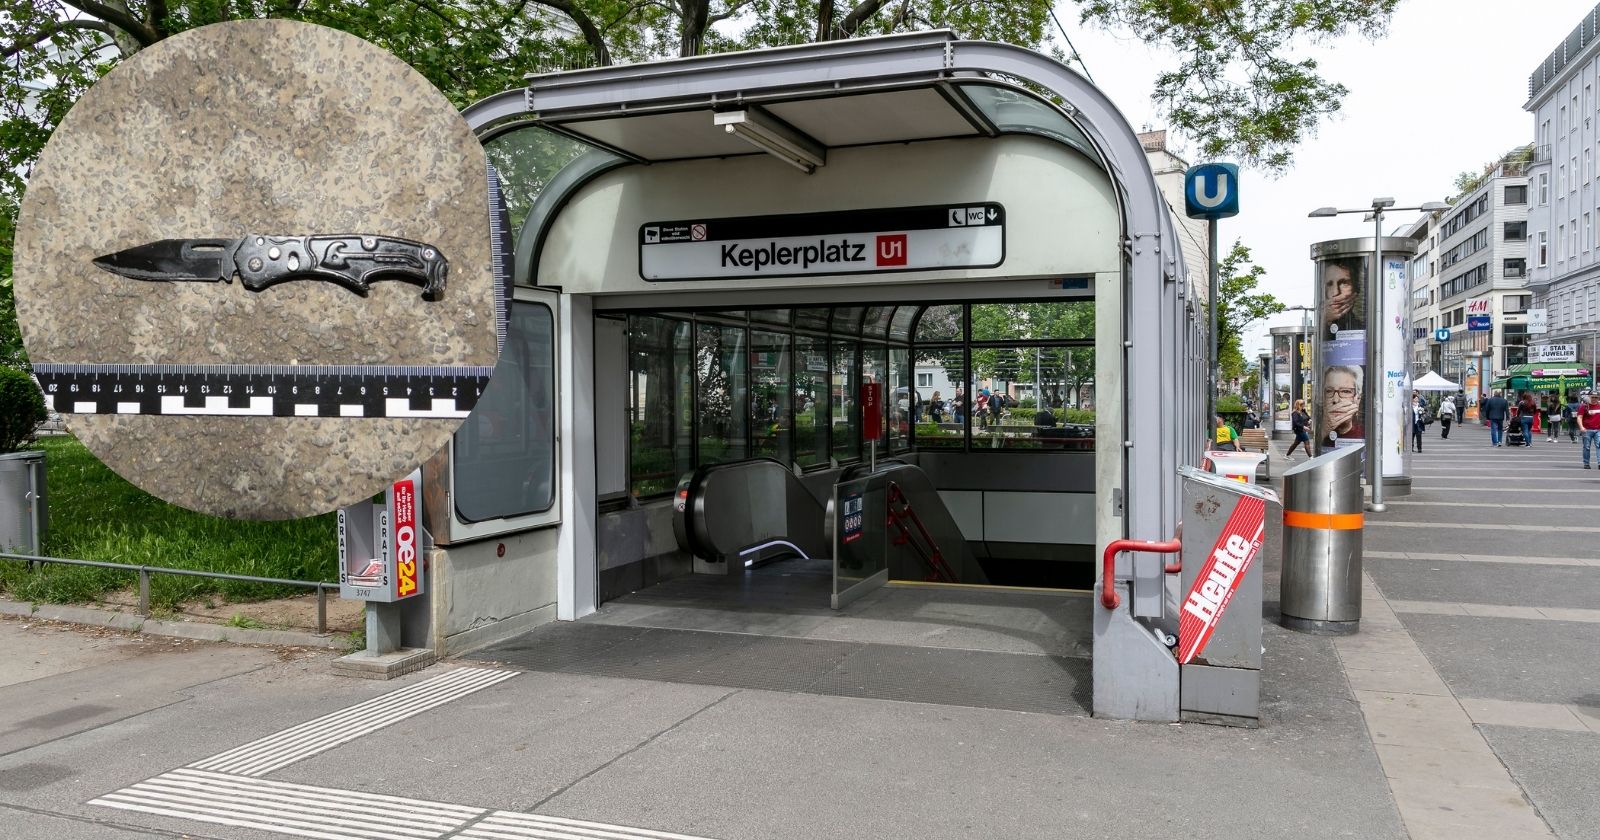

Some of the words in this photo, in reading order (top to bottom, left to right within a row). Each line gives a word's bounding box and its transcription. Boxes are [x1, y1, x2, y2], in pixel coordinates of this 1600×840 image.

[1195, 174, 1227, 207] U
[968, 211, 984, 220] WC
[721, 240, 866, 271] Keplerplatz
[881, 240, 903, 260] U1
[1468, 300, 1488, 312] H&M
[1438, 331, 1448, 339] U
[48, 384, 58, 392] 20
[70, 384, 80, 392] 19
[92, 384, 100, 392] 18
[114, 384, 122, 392] 17
[136, 384, 144, 392] 16
[158, 385, 166, 394] 15
[179, 385, 188, 394] 14
[201, 385, 210, 394] 13
[224, 385, 232, 394] 12
[246, 385, 254, 394] 11
[268, 386, 277, 394] 10
[292, 386, 298, 394] 9
[315, 386, 320, 394] 8
[337, 386, 342, 394] 7
[360, 386, 366, 395] 6
[383, 386, 388, 396] 5
[406, 387, 412, 396] 4
[429, 387, 434, 396] 3
[452, 388, 457, 396] 2
[338, 514, 346, 583] GRATIS
[1183, 533, 1251, 624] Heute
[356, 589, 371, 597] 3747
